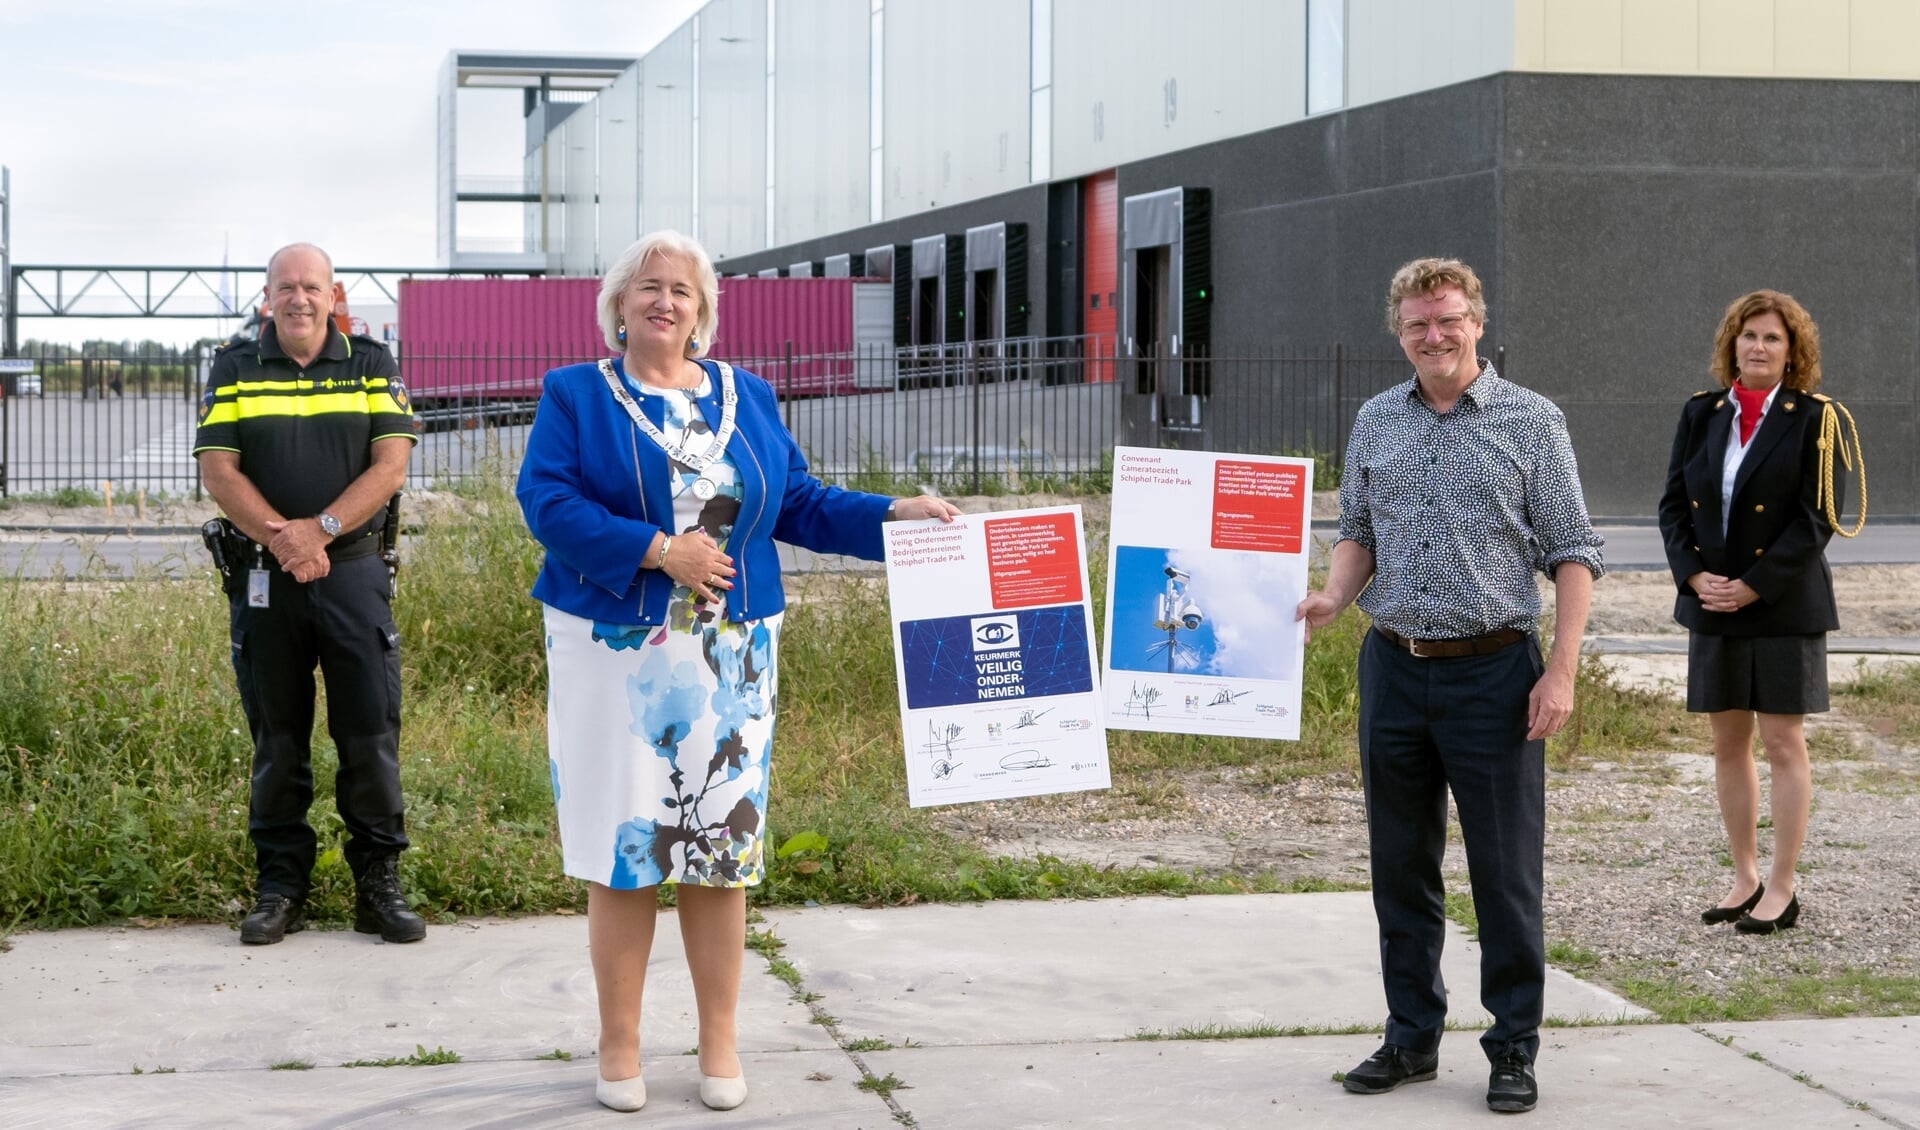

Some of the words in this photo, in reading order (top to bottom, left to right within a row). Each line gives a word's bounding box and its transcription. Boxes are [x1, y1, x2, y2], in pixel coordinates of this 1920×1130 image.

[1163, 78, 1176, 122] 19
[1122, 454, 1161, 463] Convenant
[1121, 464, 1178, 474] Cameratoezicht
[1120, 474, 1152, 484] Schiphol
[890, 526, 930, 536] Convenant
[932, 523, 968, 532] Keurmerk
[891, 536, 912, 547] Veilig
[914, 534, 962, 544] Ondernemen
[892, 544, 960, 556] Bedrijventerreinen
[893, 556, 924, 567] Schiphol
[926, 555, 947, 564] Trade
[948, 553, 965, 561] Park
[974, 650, 1021, 662] KEURMERK
[976, 660, 1023, 674] VEILIG
[977, 674, 1023, 687] ONDER-
[978, 685, 1025, 699] NEMEN
